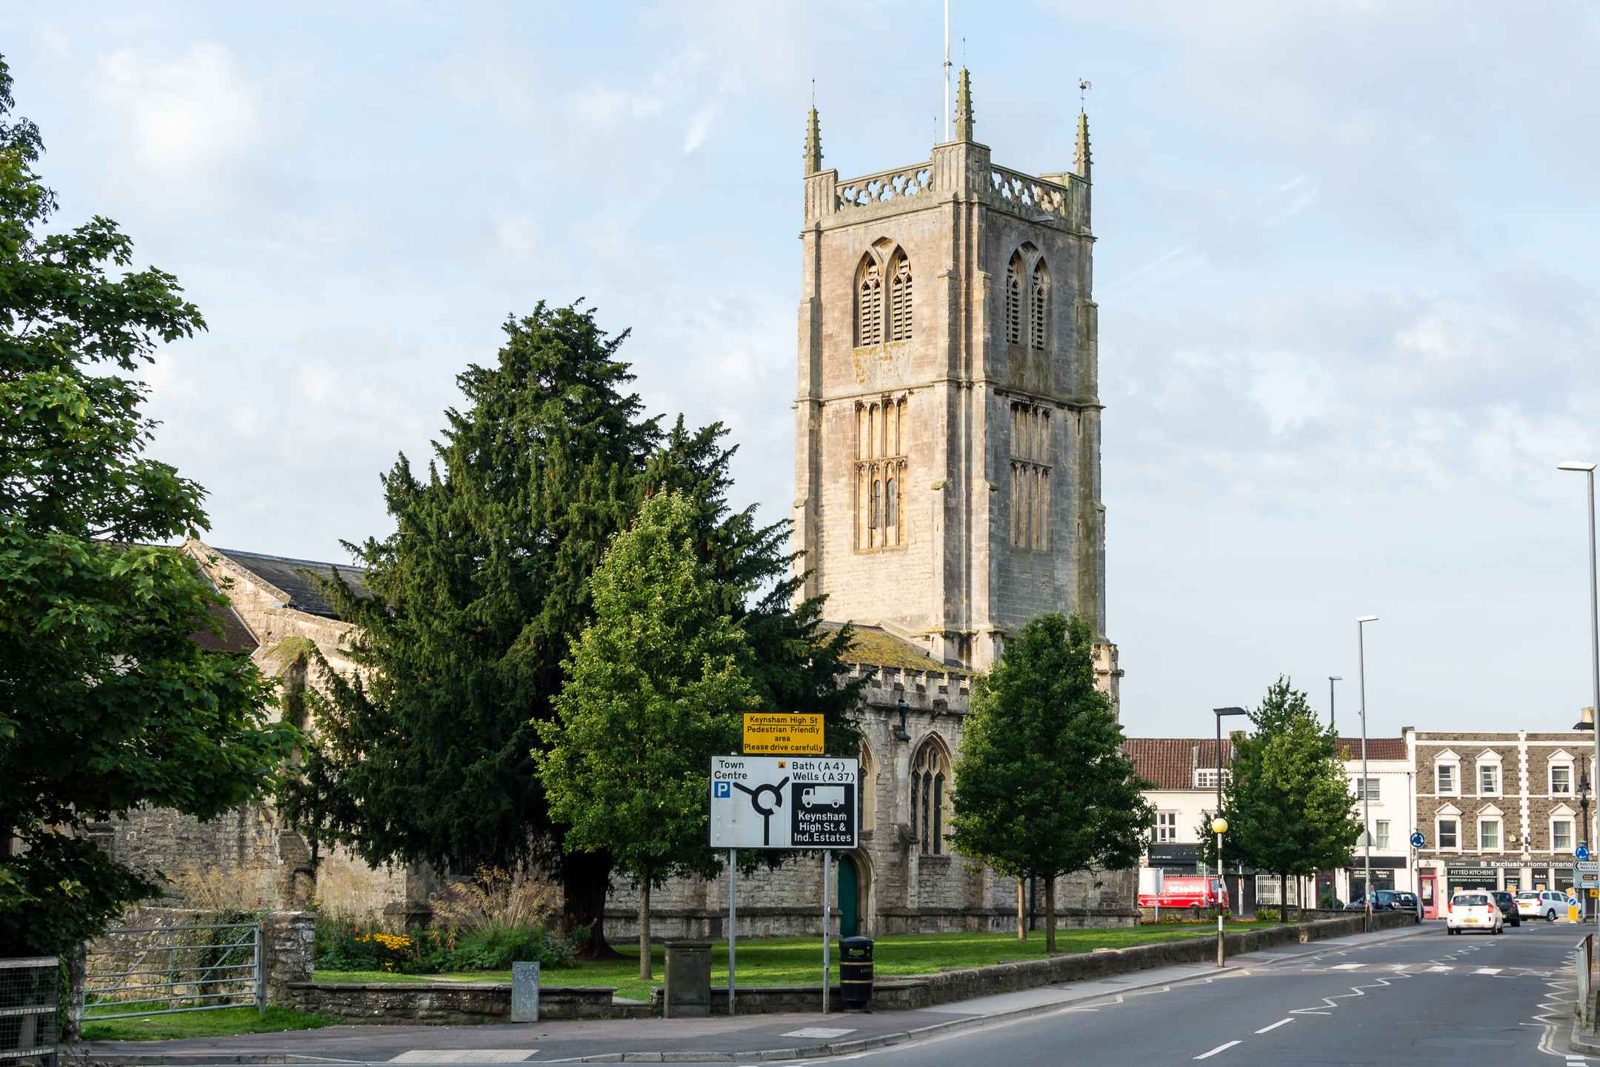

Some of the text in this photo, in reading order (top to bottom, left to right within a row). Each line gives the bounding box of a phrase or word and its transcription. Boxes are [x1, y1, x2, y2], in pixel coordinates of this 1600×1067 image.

[749, 715, 818, 724] Keynsham High St
[790, 726, 820, 734] Friendly
[770, 743, 789, 751] drive
[790, 744, 823, 752] carefully
[719, 760, 744, 768] Town
[792, 761, 815, 770] Bath
[714, 770, 748, 780] Centre
[792, 772, 819, 781] Wells
[717, 782, 729, 797] P
[797, 811, 847, 823] Keynsham
[799, 823, 846, 833] High St. &
[793, 833, 852, 842] Ind. Estates
